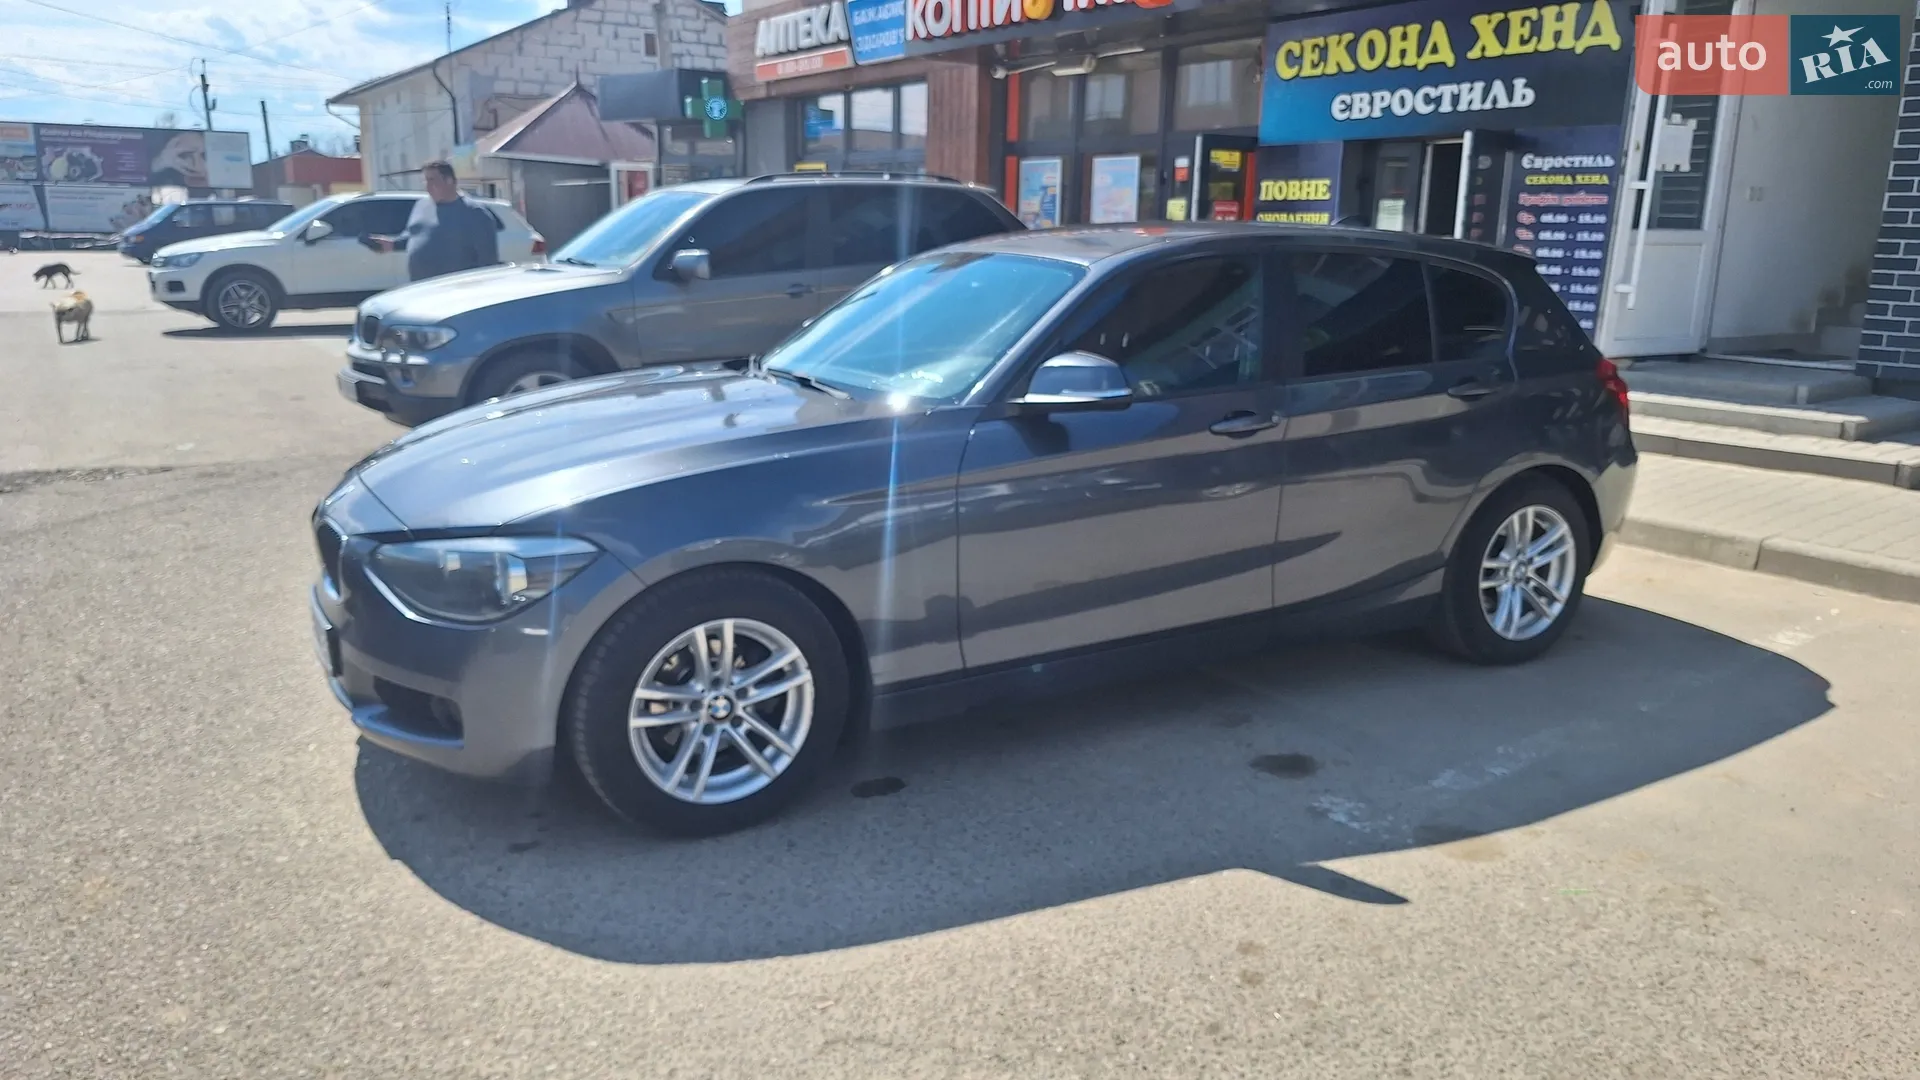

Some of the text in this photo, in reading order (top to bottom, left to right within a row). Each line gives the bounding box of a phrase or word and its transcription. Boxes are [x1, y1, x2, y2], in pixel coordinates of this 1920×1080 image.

[755, 1, 849, 57] АПТЕКА
[1275, 0, 1622, 81] СЕКОНД ХЕНД
[1331, 78, 1536, 121] ЄВРОСТИЛЬ
[1259, 179, 1331, 201] ПОВНЕ
[1525, 174, 1609, 185] СЕКОНД ХЕНД
